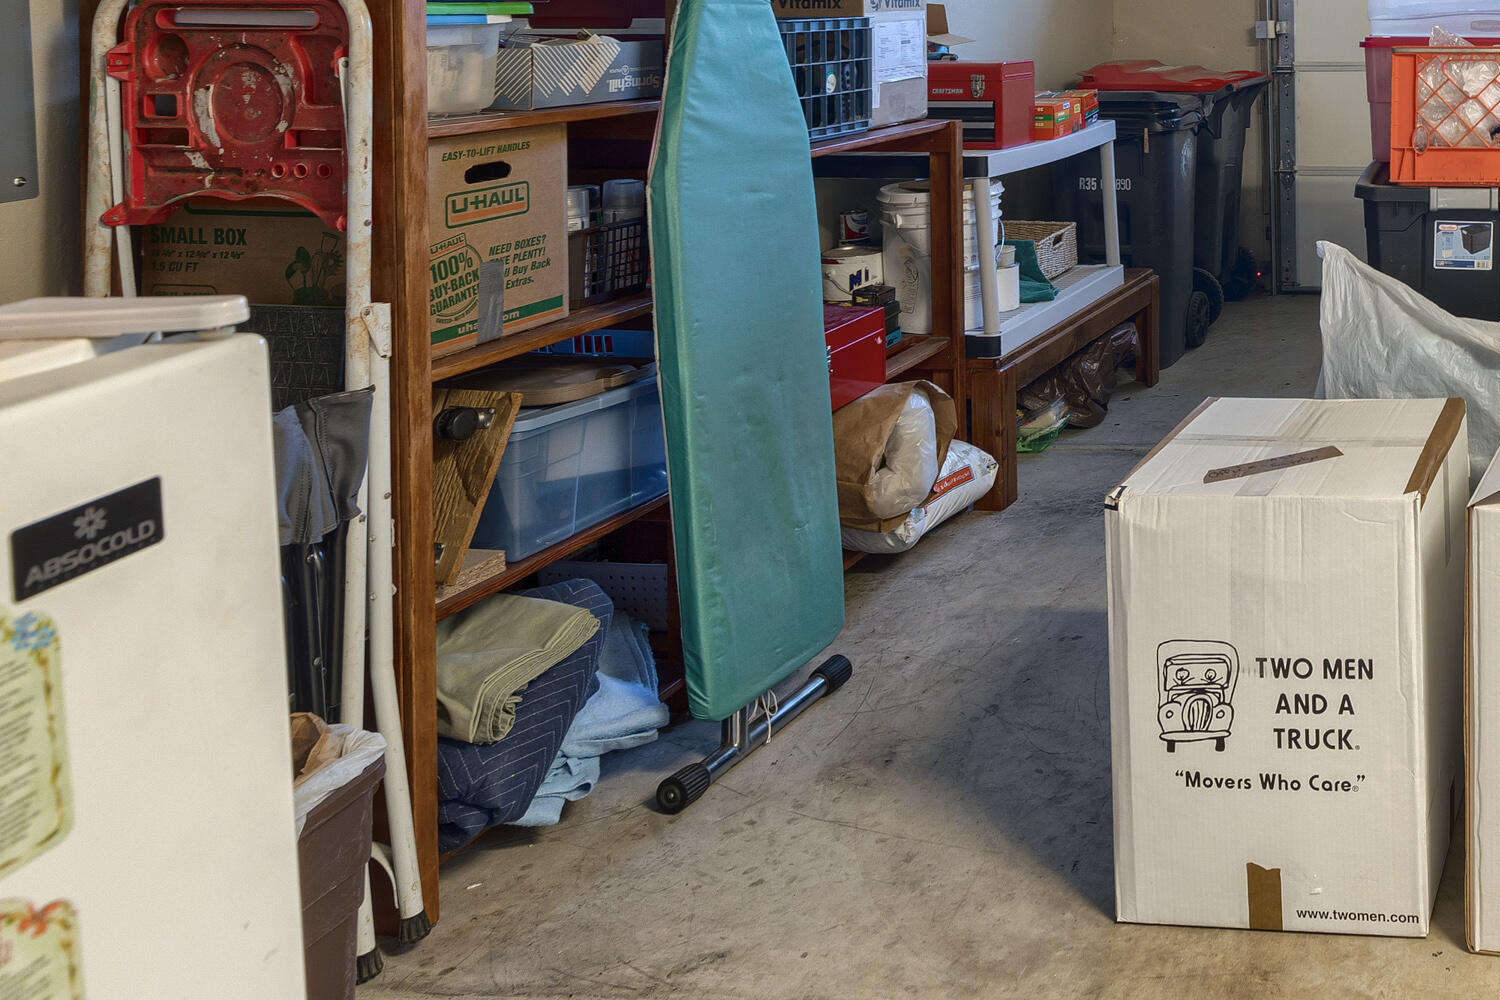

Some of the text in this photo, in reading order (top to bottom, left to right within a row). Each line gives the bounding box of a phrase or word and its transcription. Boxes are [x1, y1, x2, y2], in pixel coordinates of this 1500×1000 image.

[441, 140, 531, 162] EASY-TO-LIFT HANDLES
[1079, 177, 1097, 191] R35
[151, 226, 248, 246] SMALL BOX
[489, 234, 547, 256] NEED BOXES?
[512, 246, 547, 263] PLENTY!
[430, 249, 474, 284] 100%
[512, 264, 528, 276] Buy
[530, 257, 551, 271] Back
[505, 276, 535, 290] Extras.
[24, 519, 156, 588] ABSOCOLD
[1255, 657, 1374, 680] TWO MEN
[1275, 693, 1355, 715] AND A
[1259, 773, 1301, 791] Who
[1296, 908, 1420, 925] www.twomen.com
